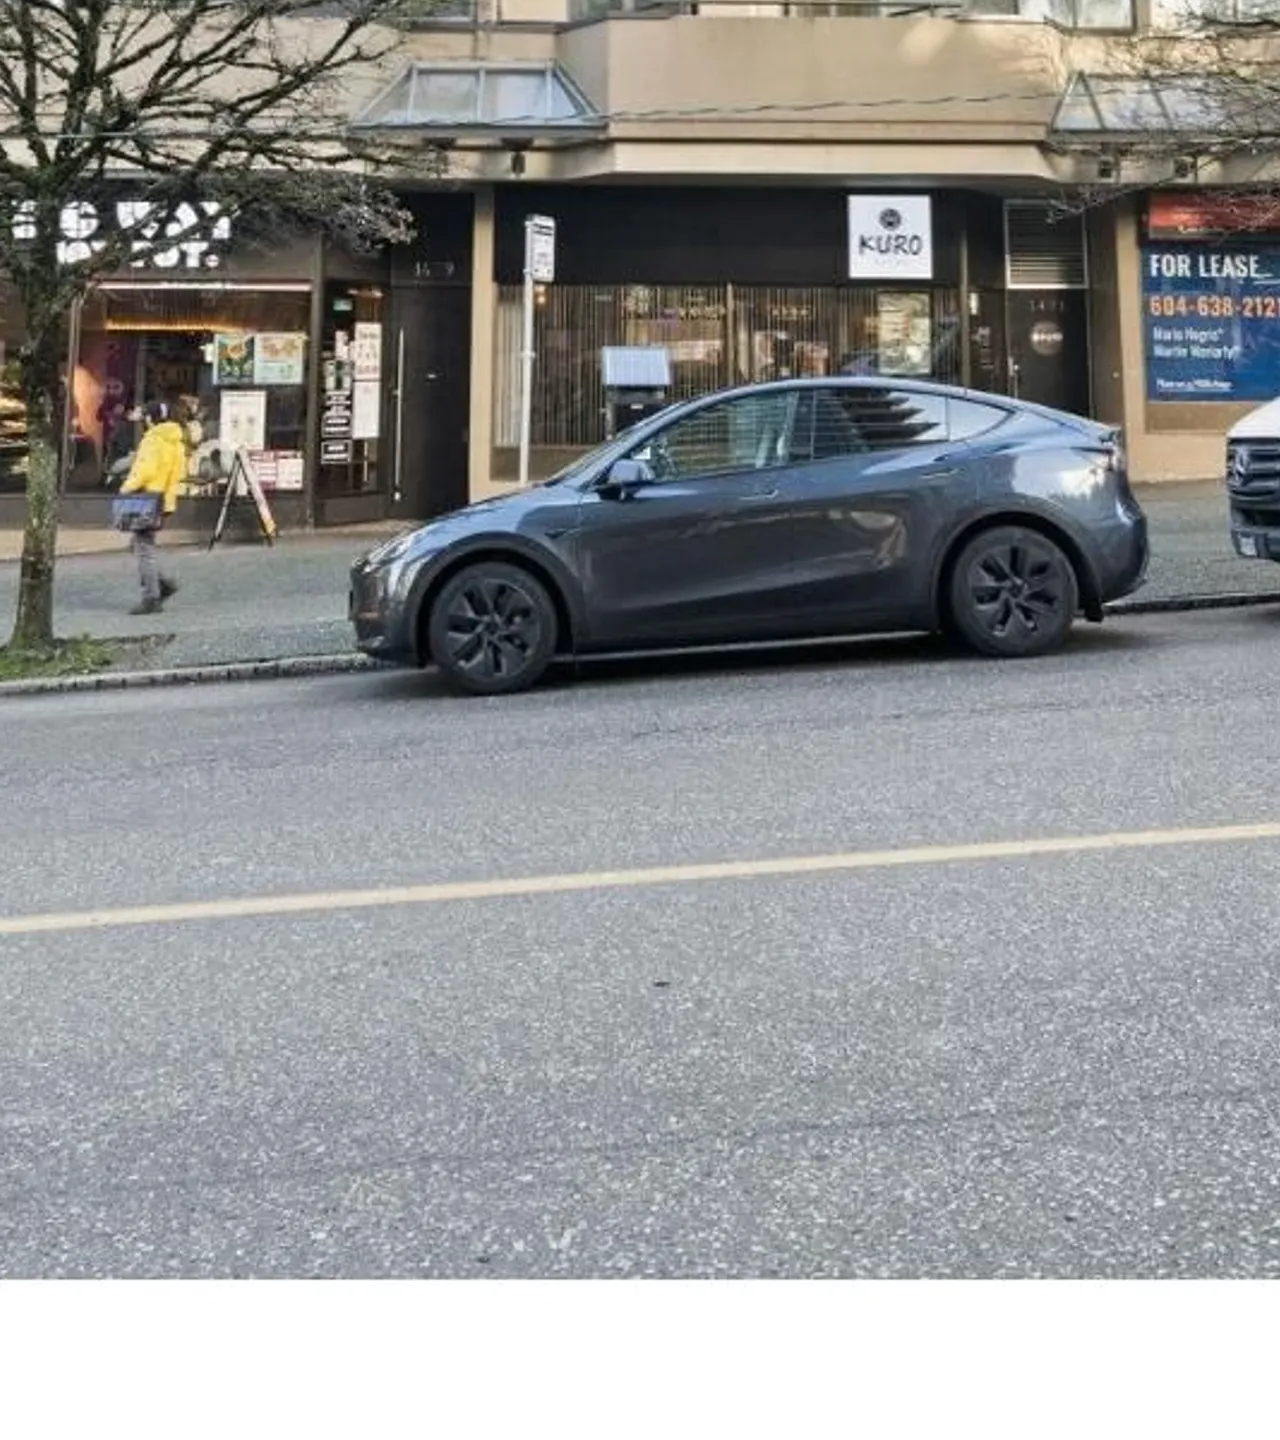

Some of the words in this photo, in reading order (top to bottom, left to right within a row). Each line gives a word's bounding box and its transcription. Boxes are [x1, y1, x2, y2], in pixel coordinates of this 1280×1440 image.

[11, 200, 100, 240] BG
[858, 233, 923, 256] KURO
[1151, 254, 1191, 278] FOR
[1198, 254, 1259, 278] LEASE
